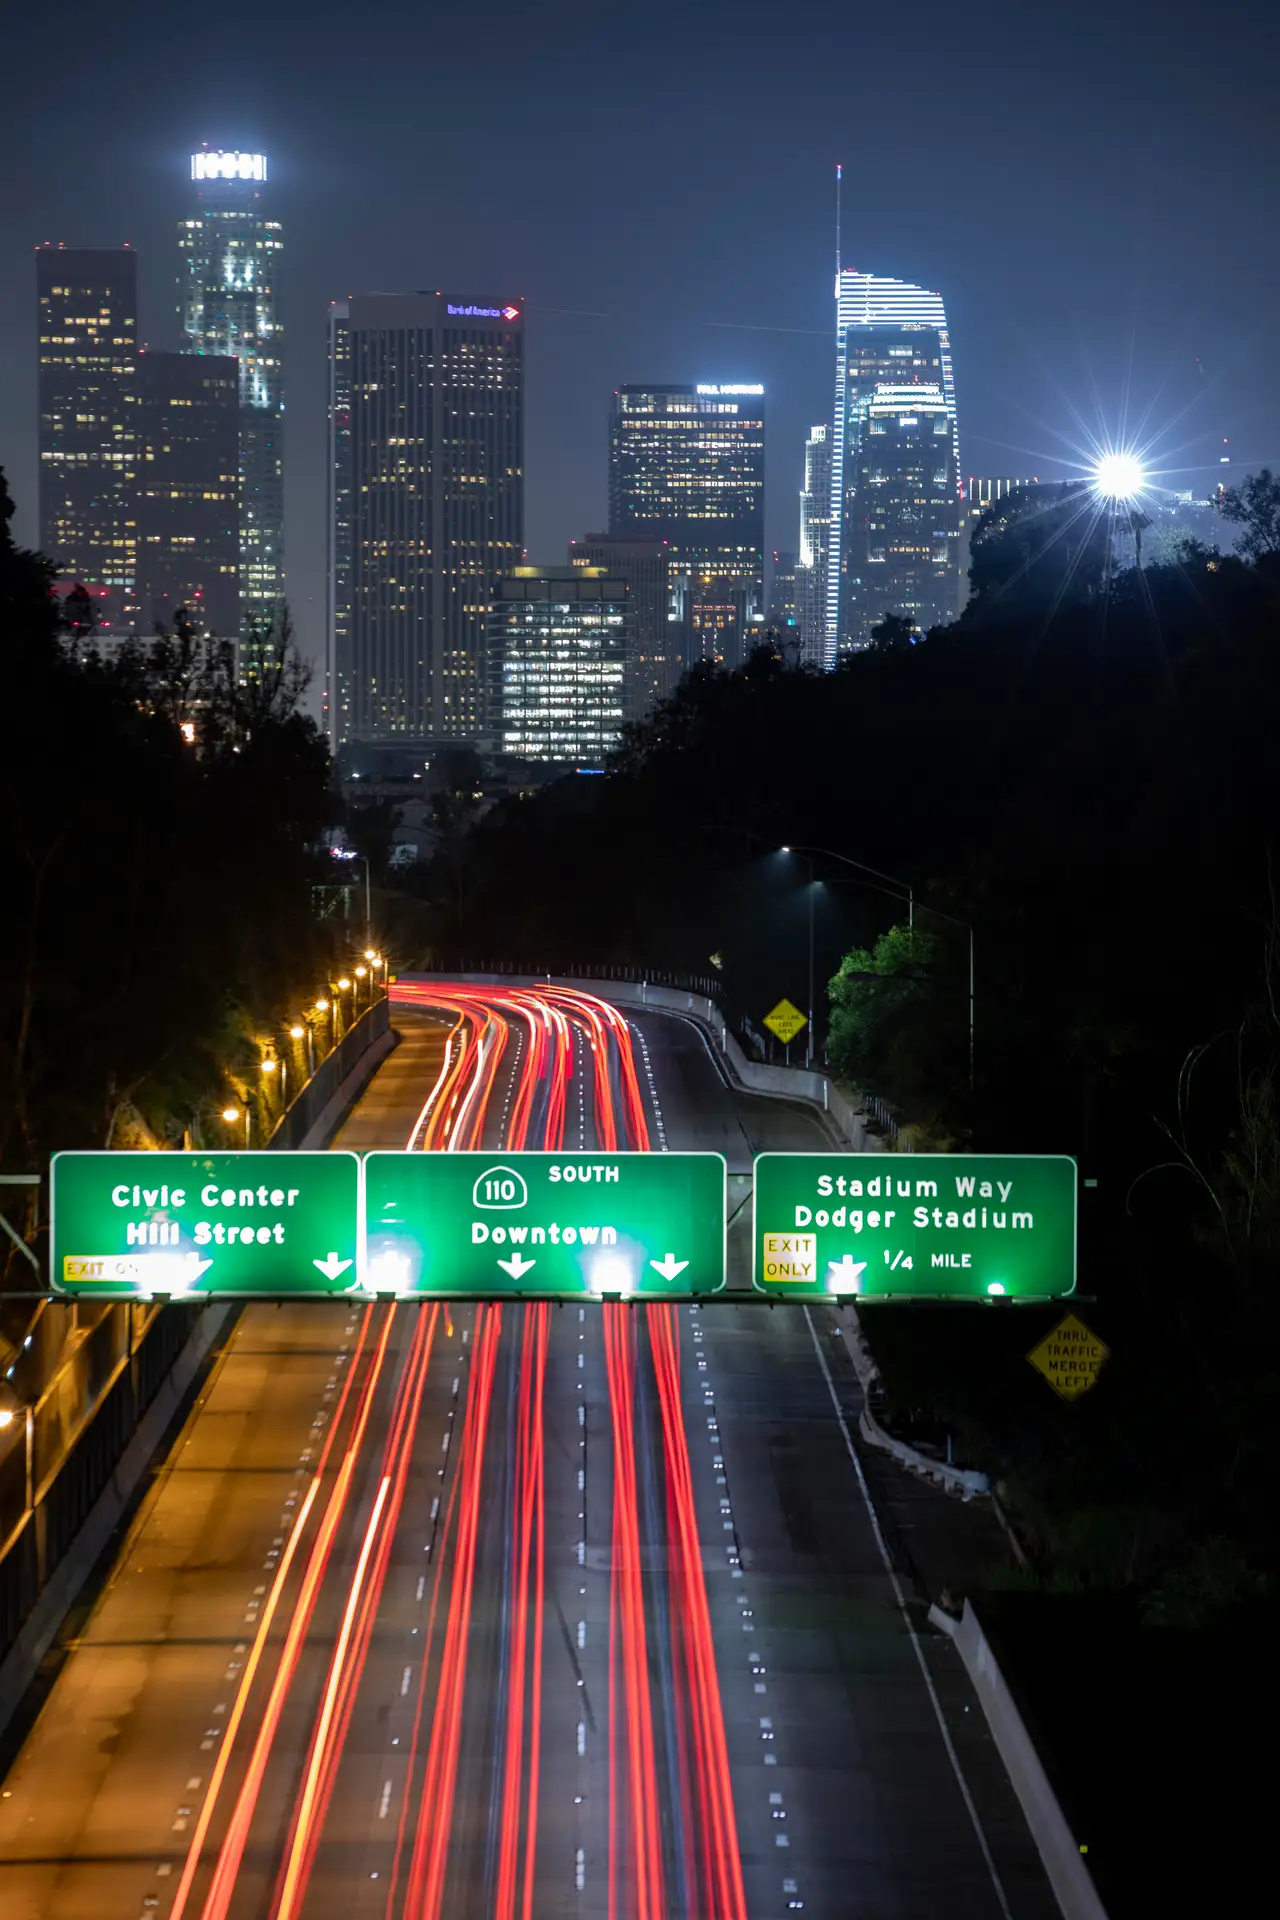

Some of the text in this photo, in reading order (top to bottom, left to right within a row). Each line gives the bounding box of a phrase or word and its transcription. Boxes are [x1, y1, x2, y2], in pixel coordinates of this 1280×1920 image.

[448, 304, 500, 316] Bank of America
[548, 1165, 619, 1183] SOUTH
[112, 1185, 300, 1207] Civic Center
[485, 1180, 515, 1200] 110
[816, 1175, 1013, 1203] Stadium Way
[795, 1205, 1034, 1234] Dodger Stadium
[126, 1221, 285, 1246] Hill Street
[471, 1221, 618, 1245] Downtown
[768, 1239, 812, 1252] EXIT
[883, 1249, 972, 1270] 1/4 MILE
[66, 1261, 105, 1276] EXIT
[767, 1262, 812, 1276] ONLY
[1057, 1329, 1088, 1342] THRU
[1047, 1344, 1099, 1358] TRAFFIC
[1048, 1360, 1098, 1373] MERGE
[1056, 1376, 1089, 1388] LEFT
